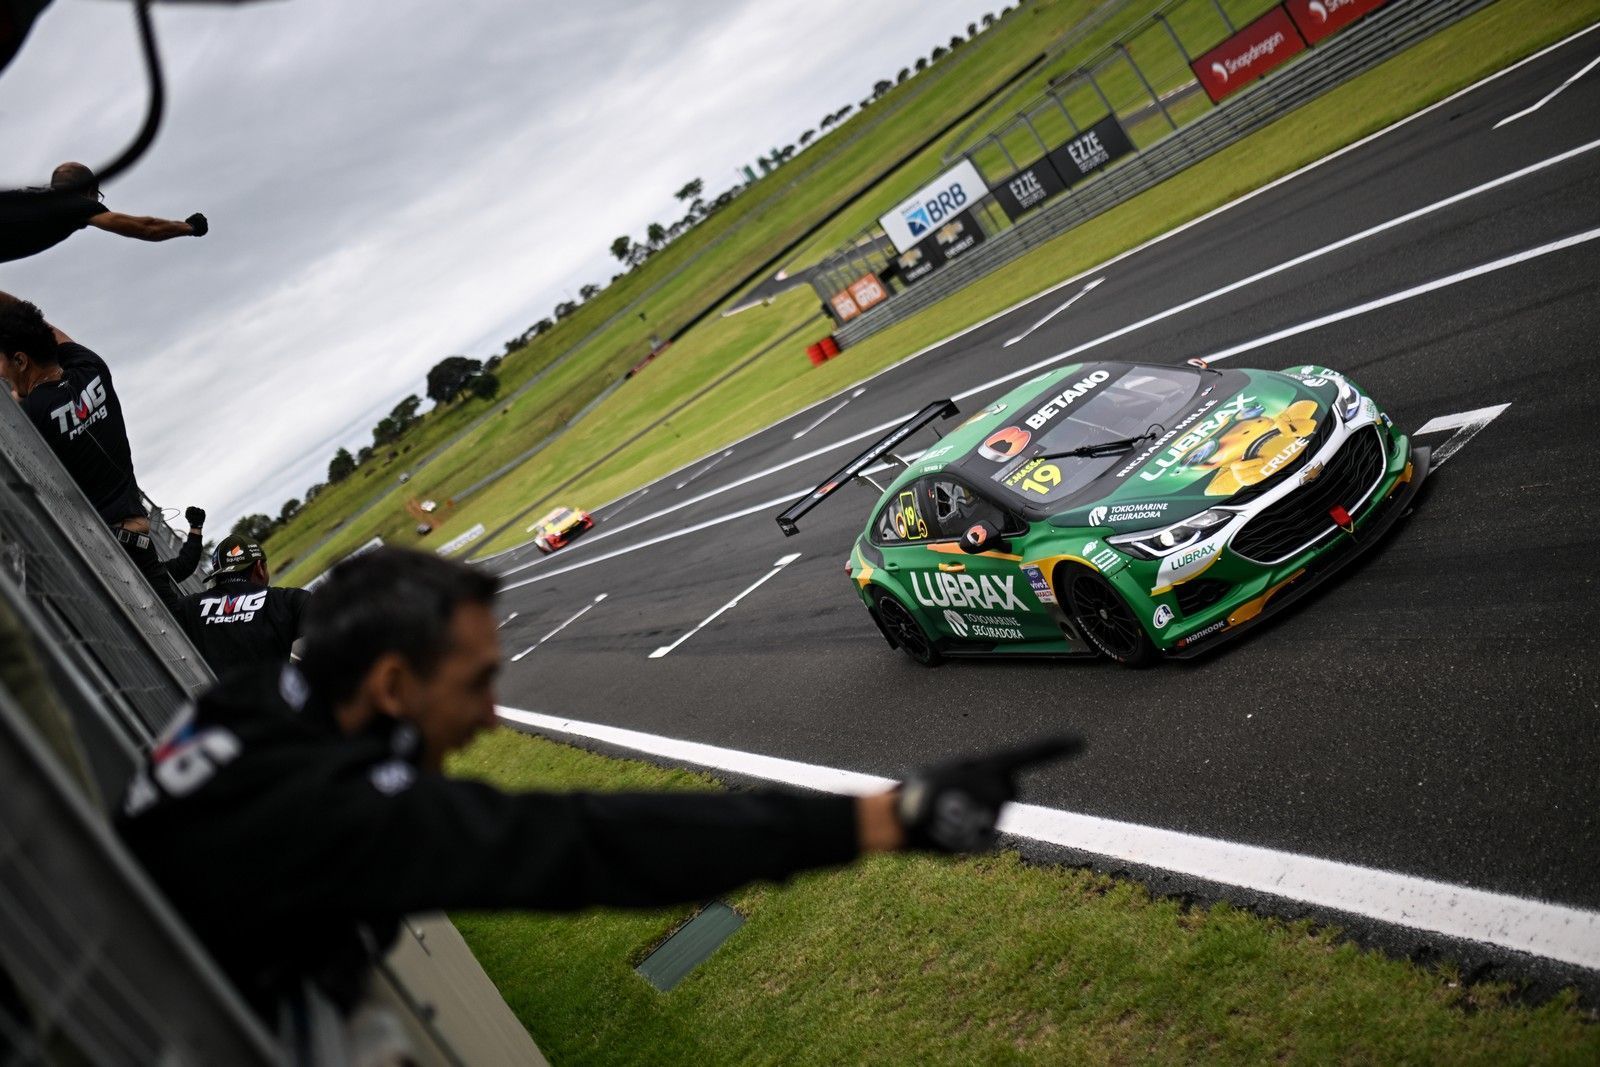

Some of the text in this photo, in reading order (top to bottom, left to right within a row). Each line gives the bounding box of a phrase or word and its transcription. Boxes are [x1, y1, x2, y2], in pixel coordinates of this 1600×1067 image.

[1224, 31, 1284, 74] Snapdragon
[1067, 131, 1103, 164] EZZE
[925, 183, 967, 222] BRB
[1009, 170, 1041, 200] EZZE
[50, 375, 106, 434] TMG
[1025, 370, 1110, 430] BETANO
[69, 404, 108, 440] racing
[1116, 399, 1218, 477] RICHARD MILLE
[1140, 393, 1257, 481] LUBRAX
[1259, 437, 1310, 477] CRUZE
[1021, 464, 1062, 495] 19
[1108, 511, 1161, 523] SEGURADORA
[1171, 543, 1216, 571] LUBRAX
[200, 590, 268, 617] TMG
[909, 571, 1030, 611] LUBRAX
[205, 611, 255, 625] racing
